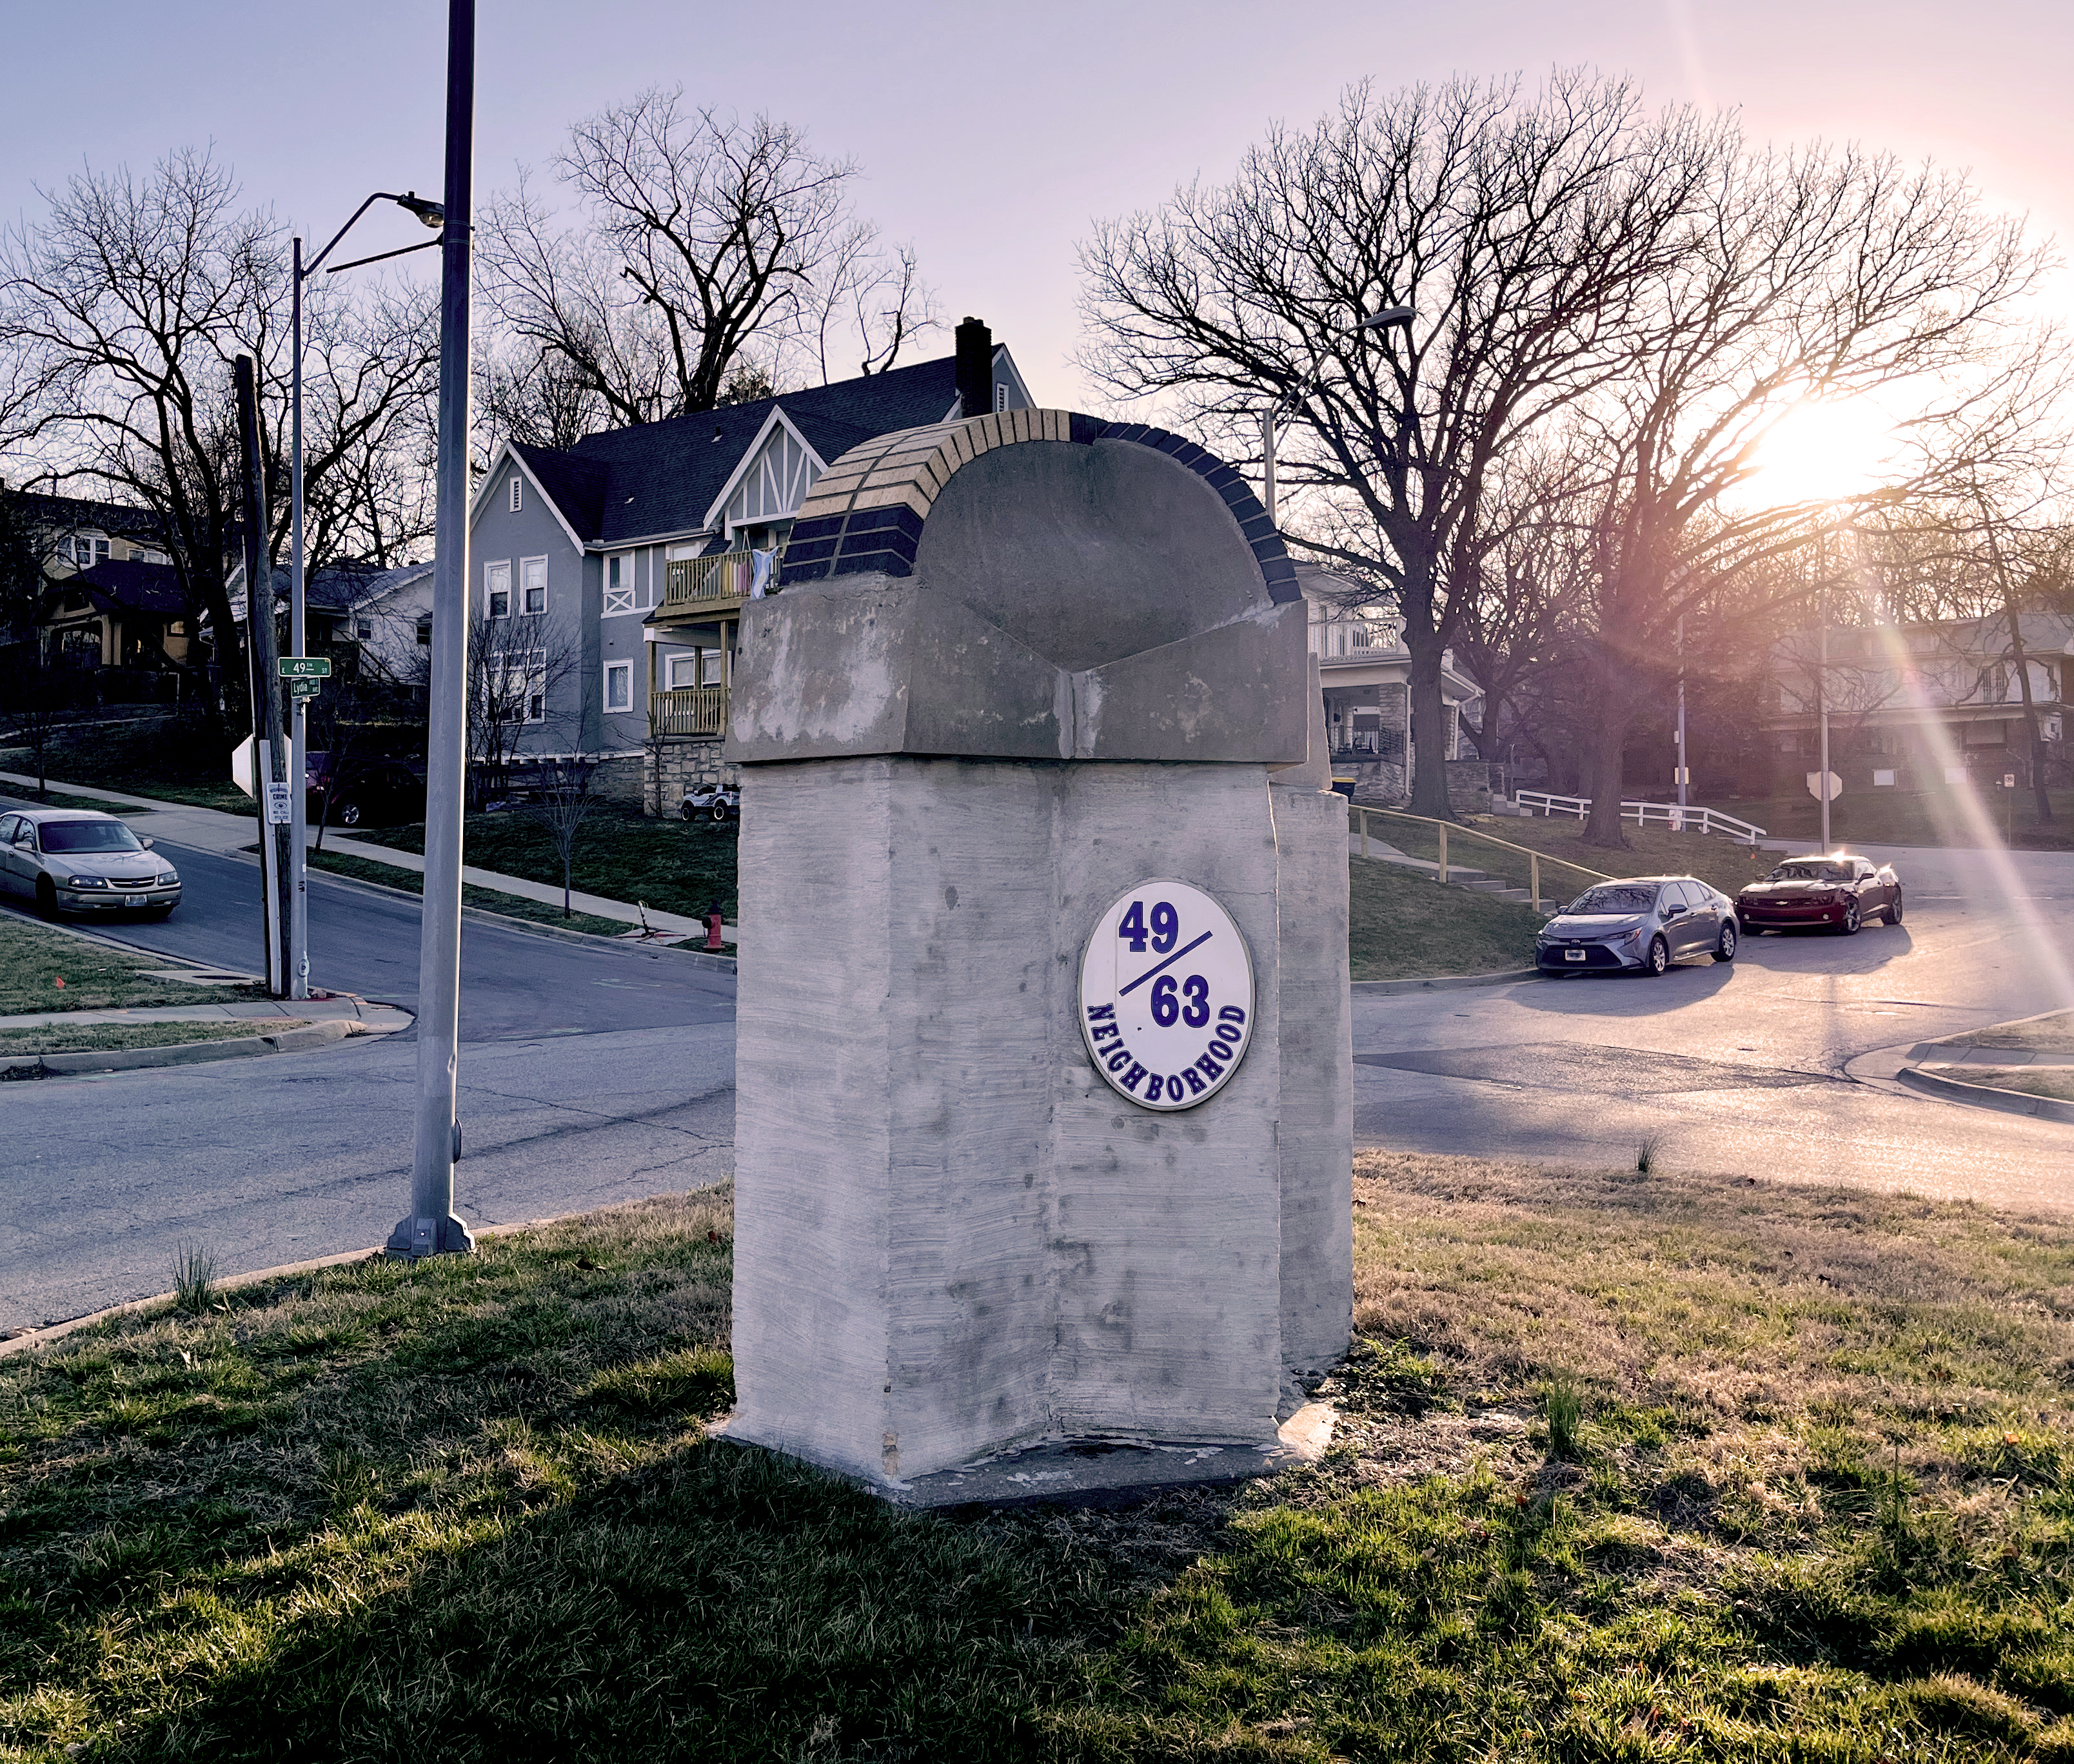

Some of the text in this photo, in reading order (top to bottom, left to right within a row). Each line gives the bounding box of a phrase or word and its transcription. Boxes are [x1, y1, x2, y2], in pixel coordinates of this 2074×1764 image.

[293, 681, 308, 695] Lydia
[1119, 901, 1179, 954] 49
[1151, 974, 1210, 1028] 63
[1087, 1003, 1246, 1102] NEIGHBORHOOD
